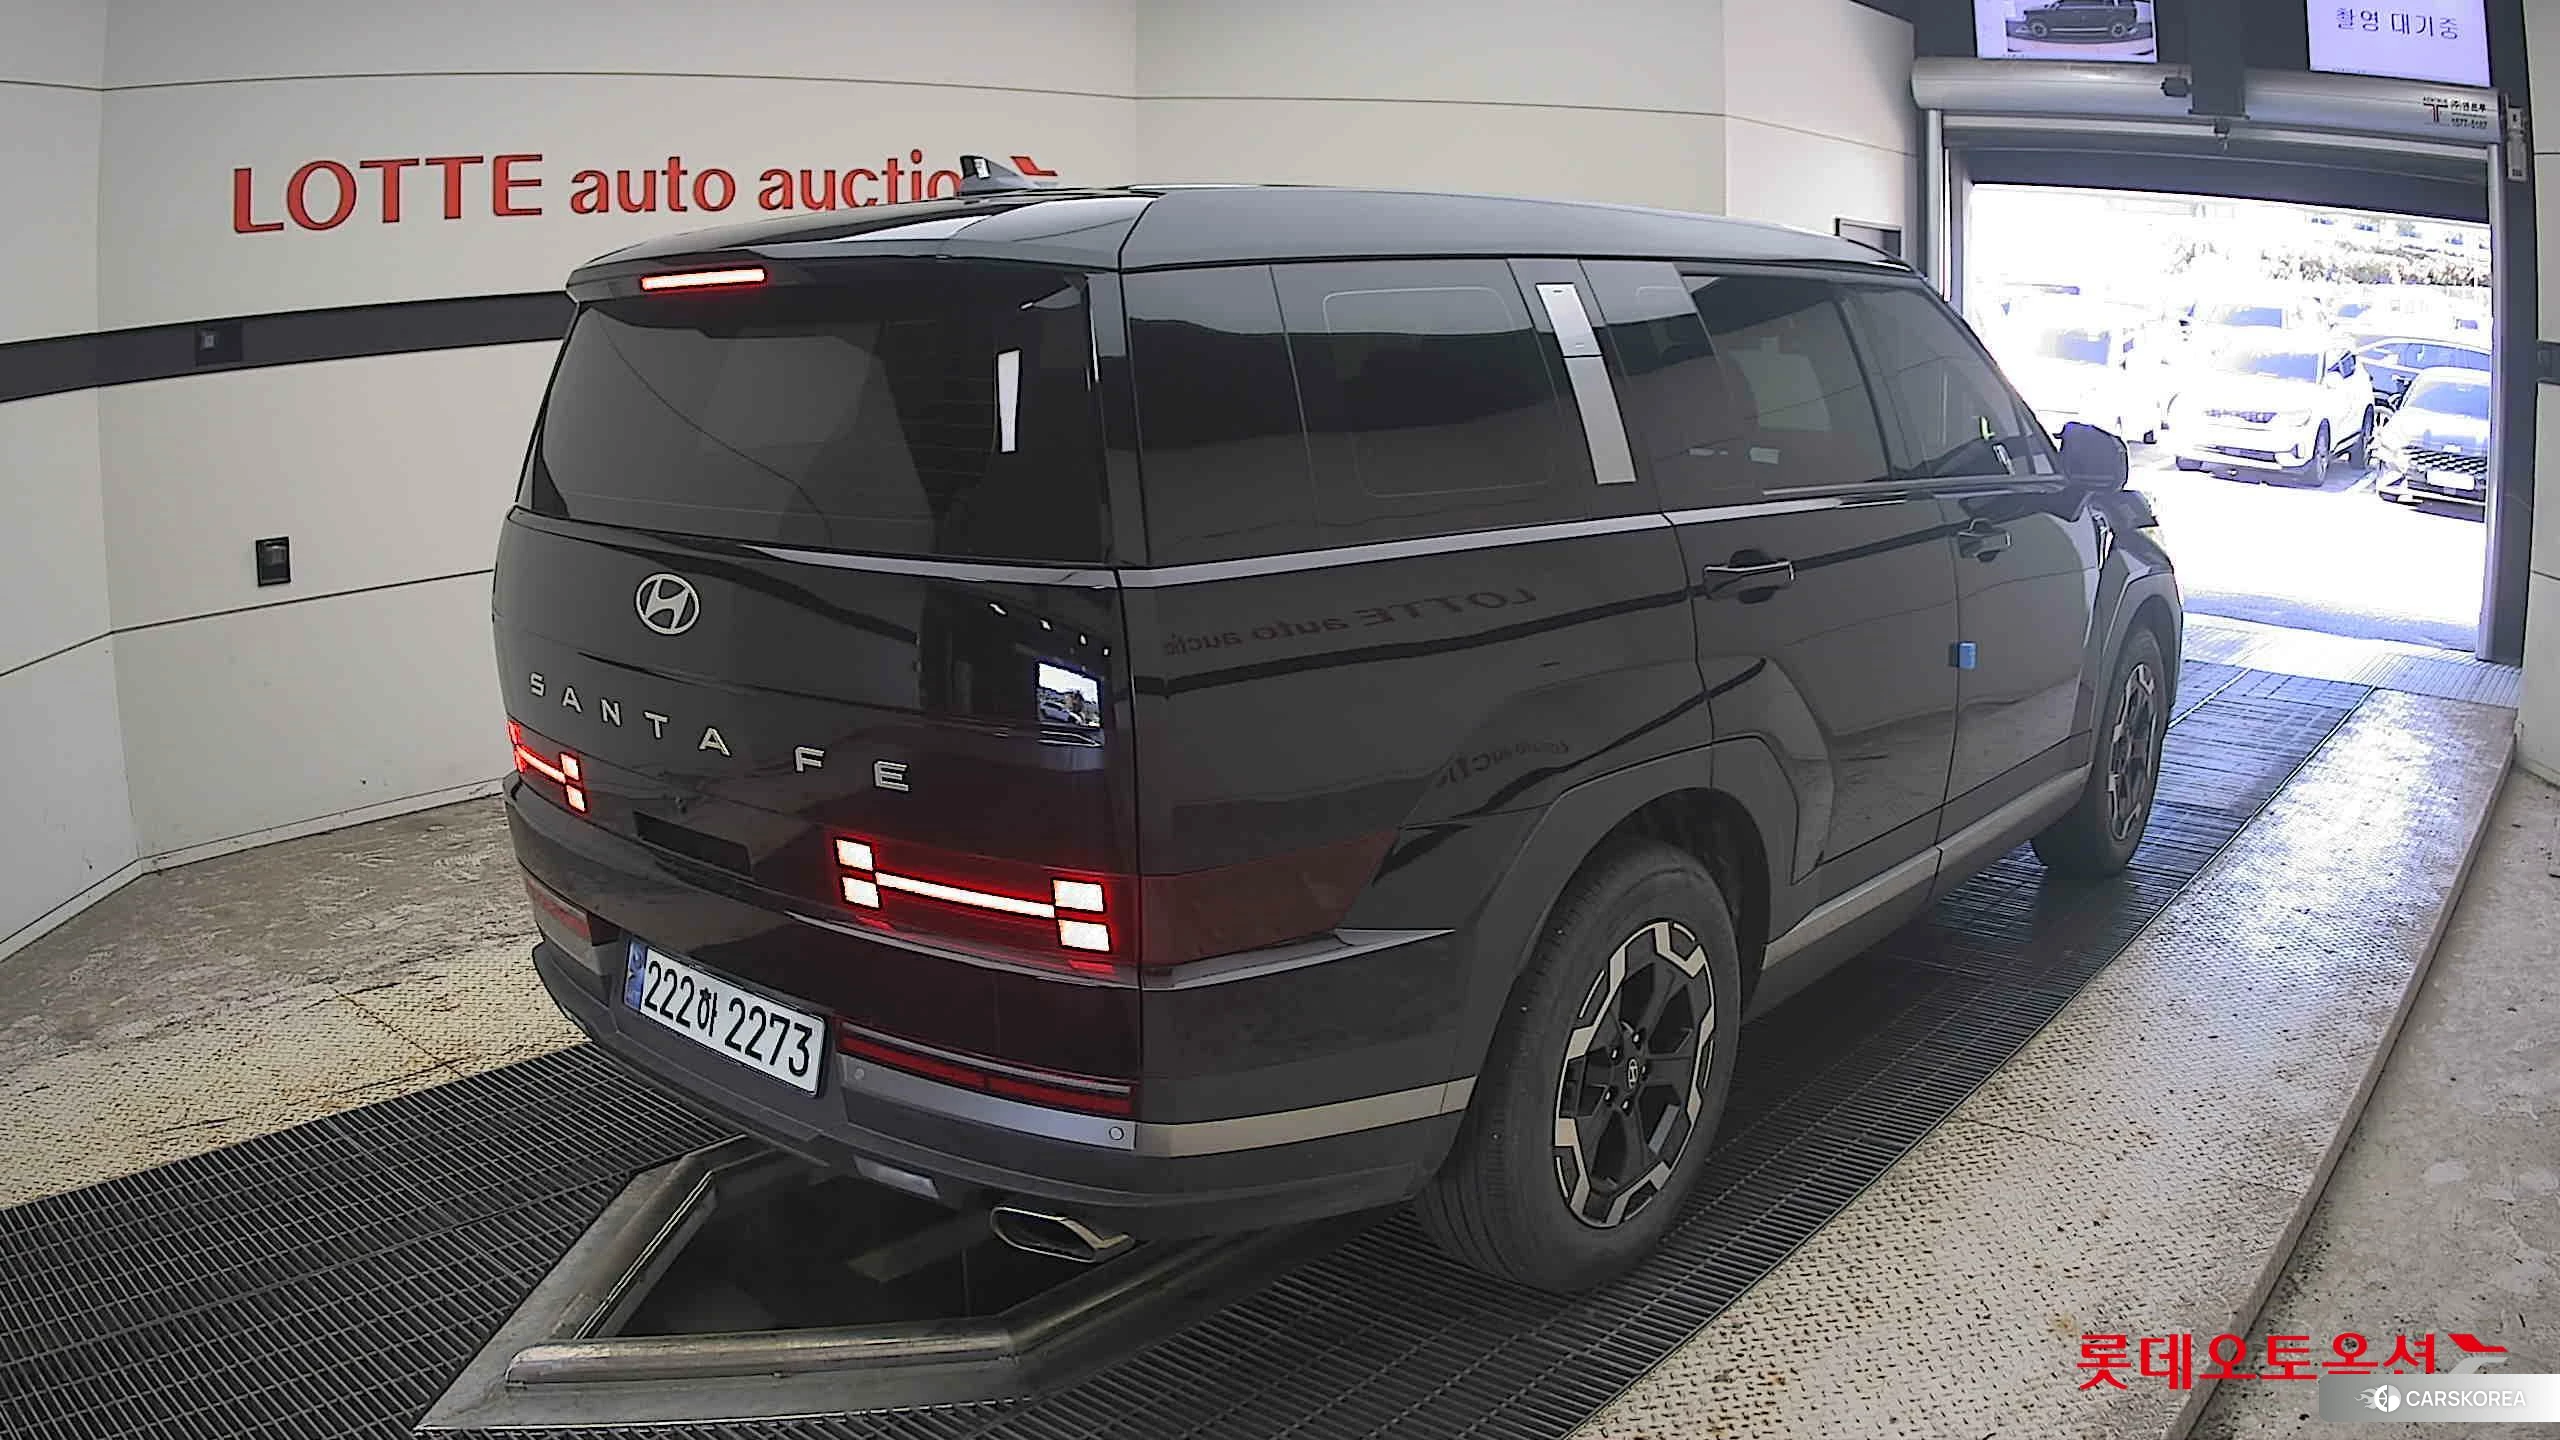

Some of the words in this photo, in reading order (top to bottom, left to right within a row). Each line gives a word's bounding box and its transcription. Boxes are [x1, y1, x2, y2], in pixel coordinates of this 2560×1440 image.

[2391, 13, 2458, 40] 대기중
[234, 153, 543, 234] LOTTE
[570, 156, 736, 214] auto
[757, 149, 962, 211] auctio
[529, 672, 731, 757] SANTA
[794, 746, 910, 792] FE
[644, 960, 718, 1037] 222하
[724, 997, 813, 1077] 2273
